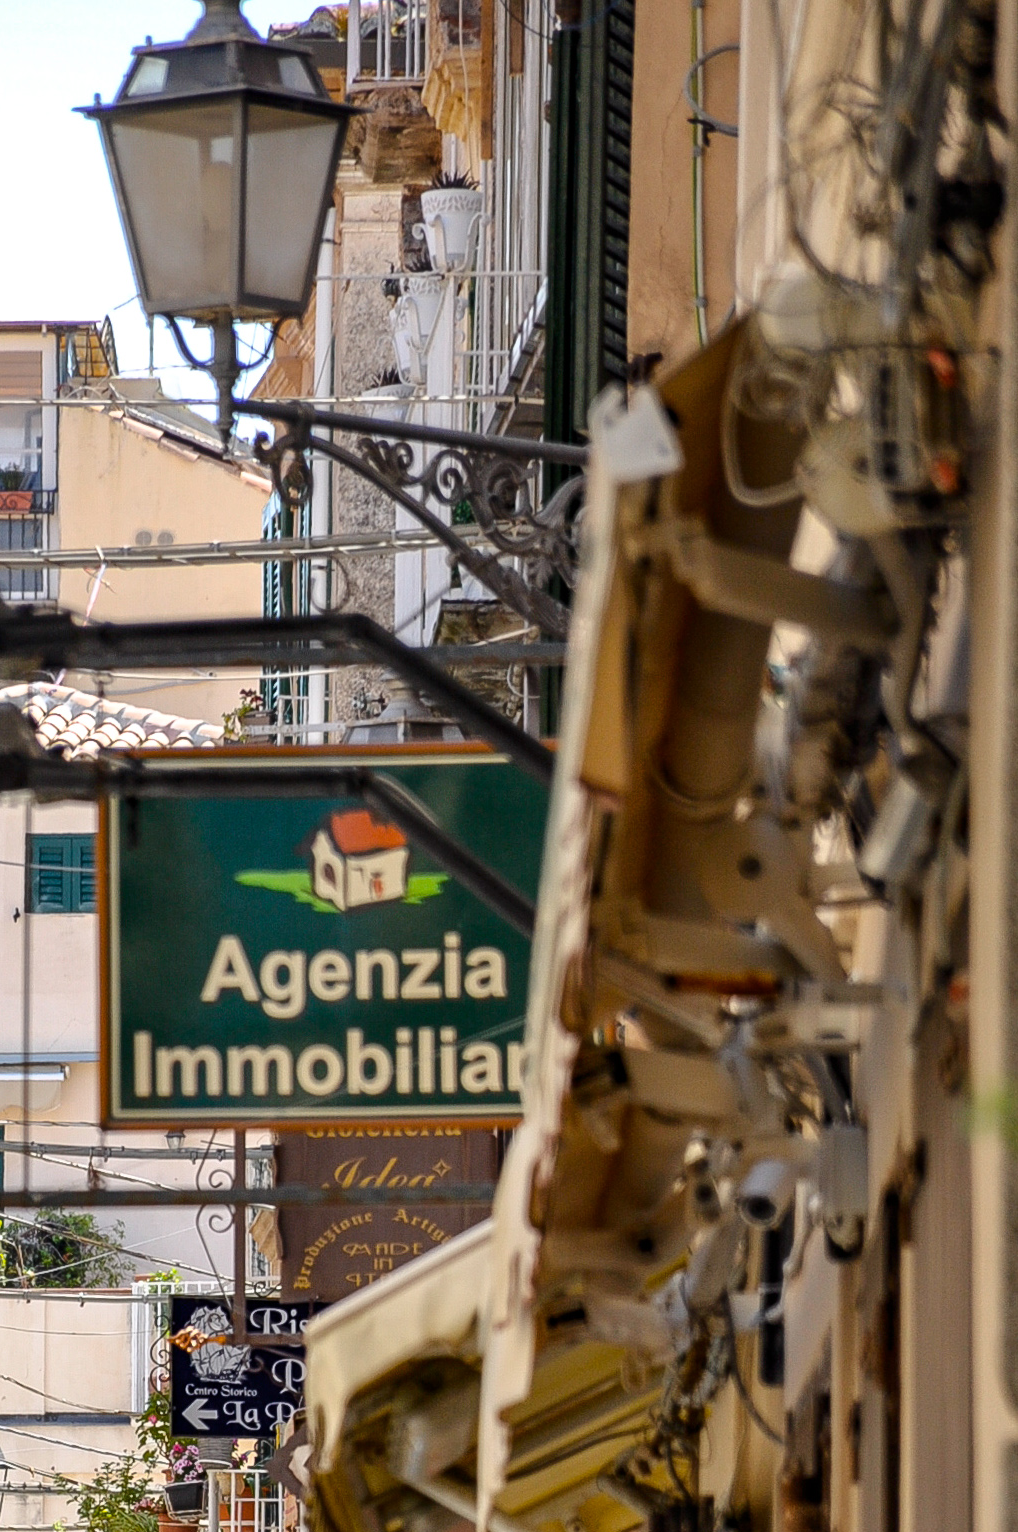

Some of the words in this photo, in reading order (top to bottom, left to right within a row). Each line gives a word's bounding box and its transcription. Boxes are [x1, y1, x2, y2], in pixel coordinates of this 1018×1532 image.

[200, 931, 508, 1019] Agenzia
[133, 1026, 525, 1098] Immobiliar
[293, 1211, 373, 1290] Produzione
[342, 1242, 424, 1257] MADE
[373, 1258, 394, 1271] IN
[184, 1383, 218, 1397] Centro
[220, 1384, 258, 1398] Storico
[223, 1401, 261, 1431] La
